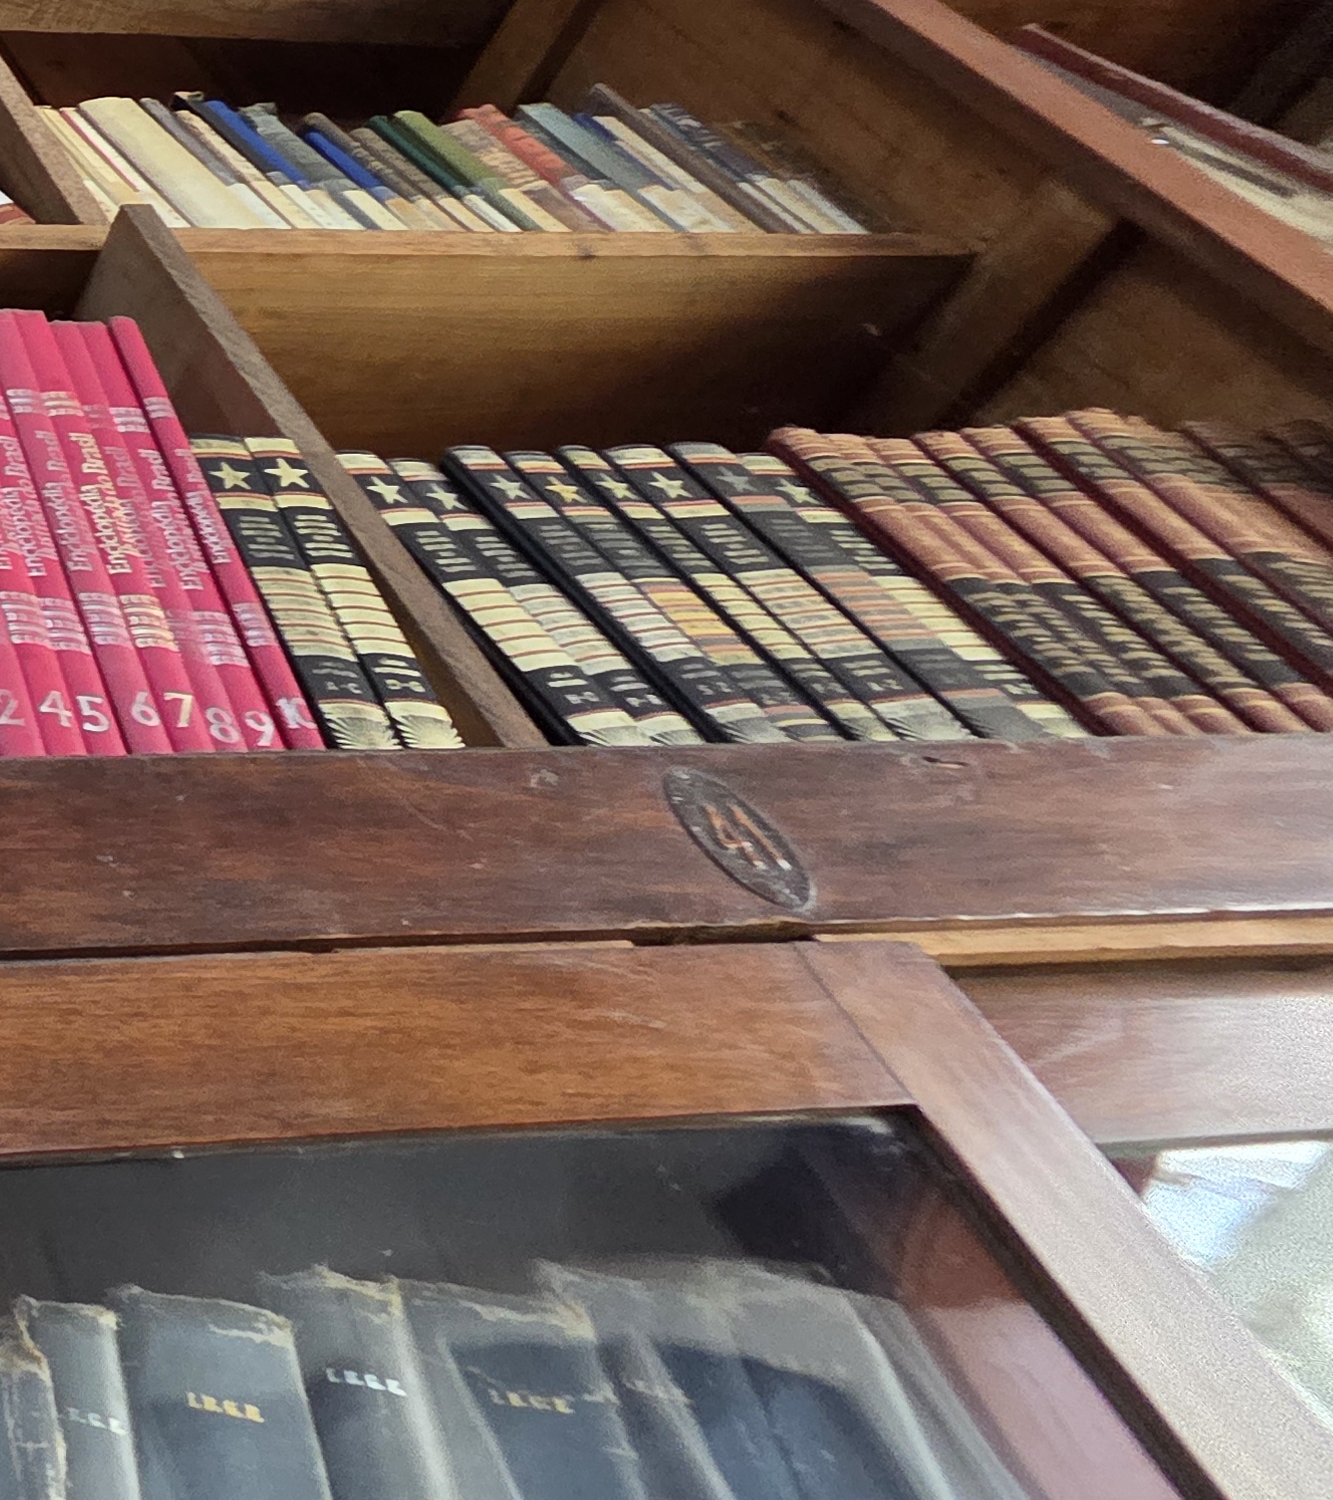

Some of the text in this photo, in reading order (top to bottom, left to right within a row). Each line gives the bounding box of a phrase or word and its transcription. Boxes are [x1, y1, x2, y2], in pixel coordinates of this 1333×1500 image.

[38, 691, 73, 728] 4
[76, 694, 110, 732] 5
[132, 691, 160, 727] 6
[164, 691, 194, 728] 7
[204, 706, 240, 744] 8
[244, 710, 274, 747] 9
